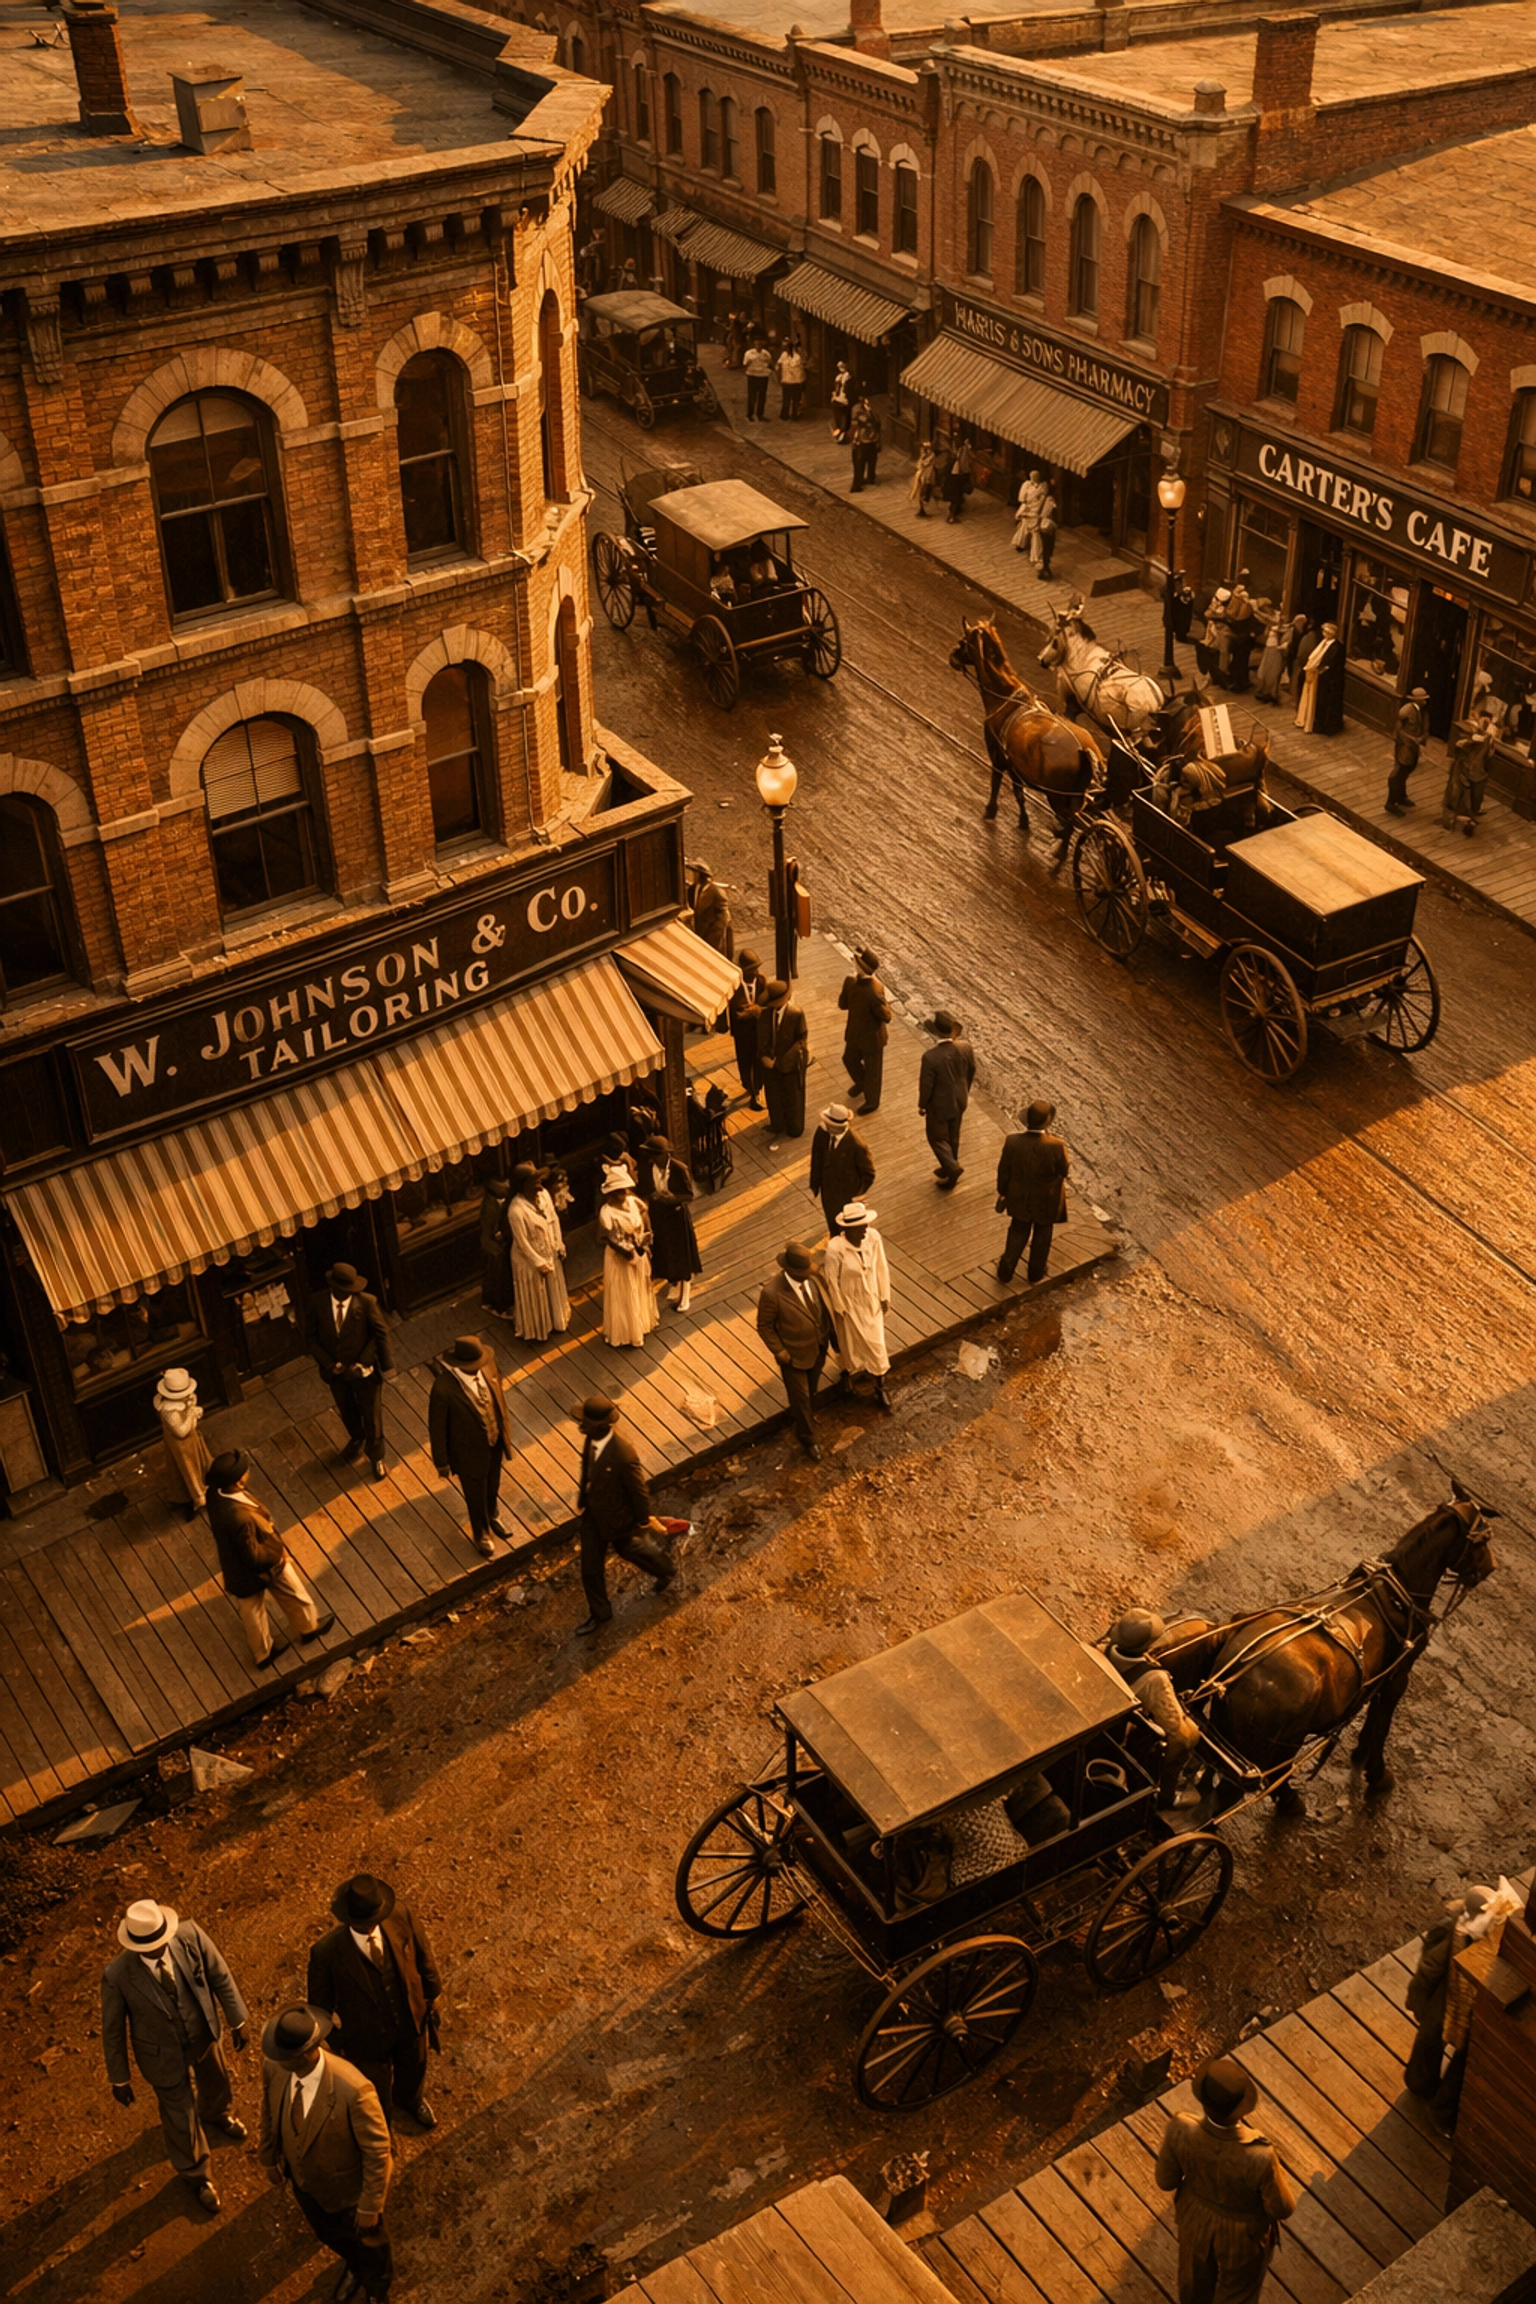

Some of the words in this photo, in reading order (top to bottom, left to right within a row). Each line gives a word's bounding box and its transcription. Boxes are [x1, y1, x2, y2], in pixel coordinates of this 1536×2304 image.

[1021, 334, 1065, 374] SONS
[1067, 353, 1156, 414] PHARMACY
[1258, 443, 1394, 531] CARTER'S
[1406, 510, 1493, 578] CAFE
[93, 1034, 178, 1098] W.
[200, 936, 440, 1061] JOHNSON
[471, 913, 506, 954] &
[237, 960, 490, 1080] TAILORING
